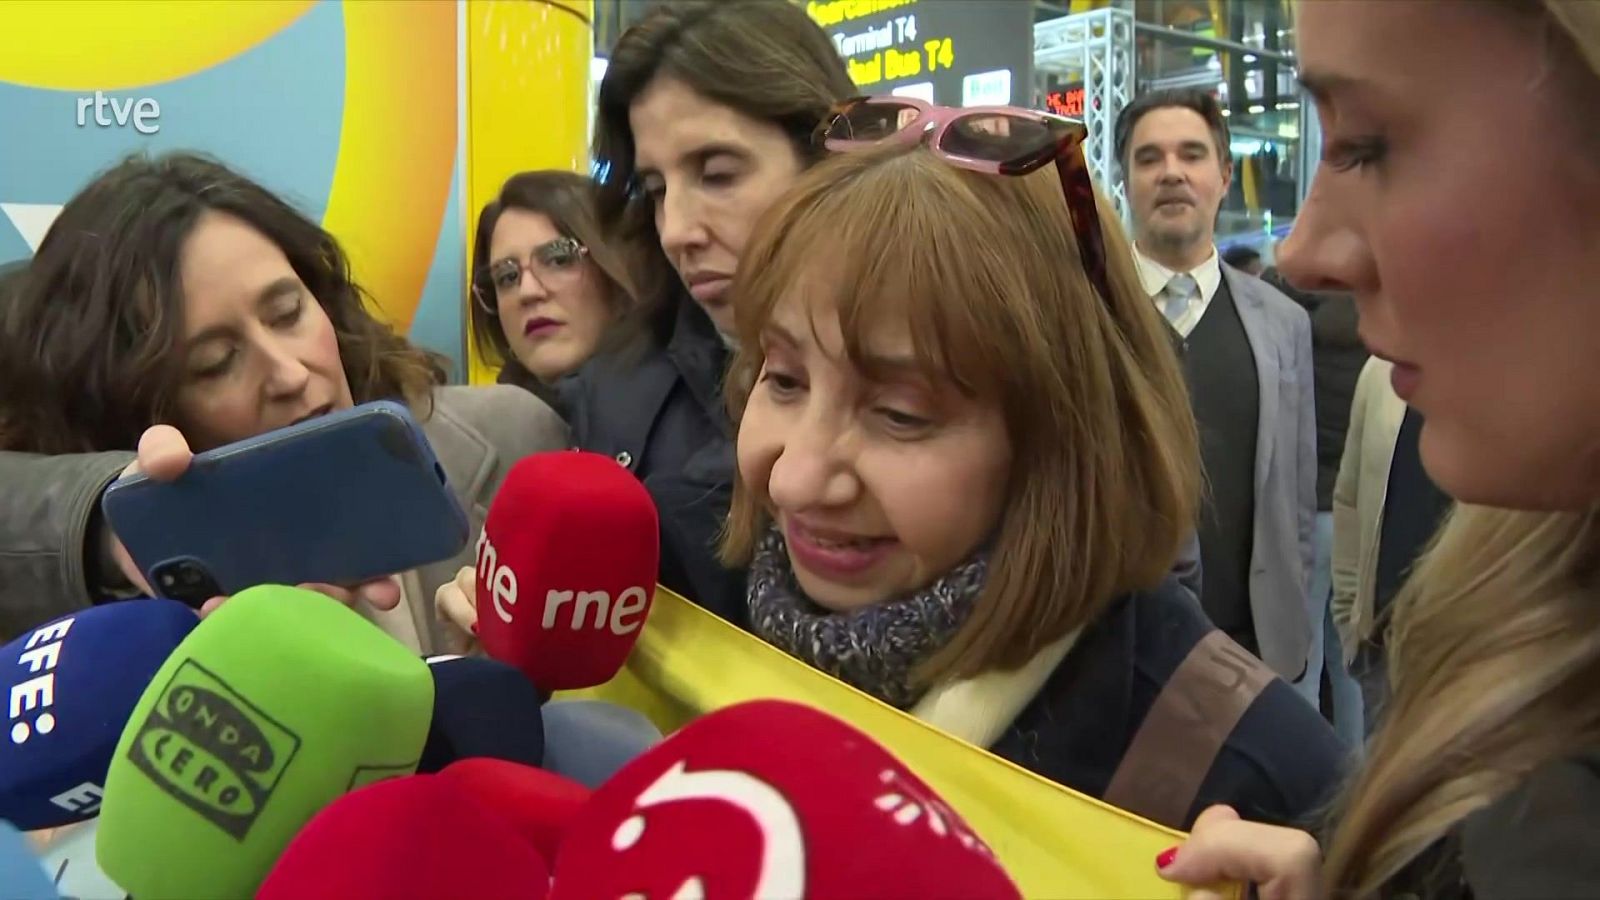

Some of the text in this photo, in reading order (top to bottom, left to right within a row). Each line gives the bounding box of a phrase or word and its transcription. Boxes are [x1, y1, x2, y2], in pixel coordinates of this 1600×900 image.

[832, 14, 917, 56] Terminal T4
[885, 48, 921, 80] Bus
[924, 37, 954, 72] T4
[541, 586, 648, 636] rne
[175, 689, 261, 765] ONDA
[154, 732, 242, 806] CERO
